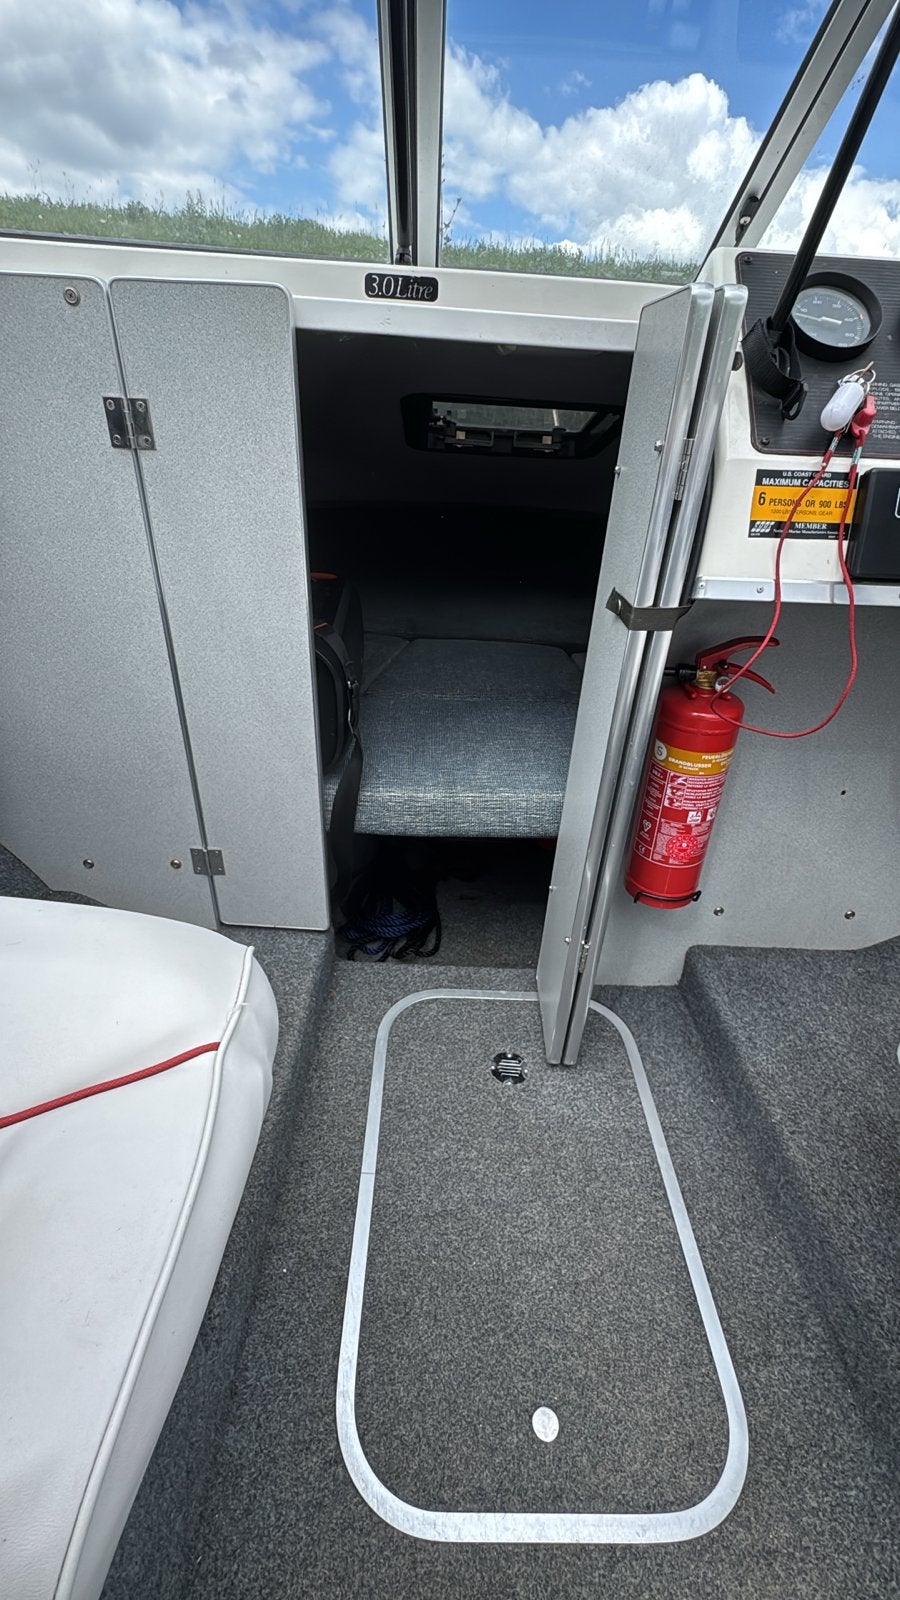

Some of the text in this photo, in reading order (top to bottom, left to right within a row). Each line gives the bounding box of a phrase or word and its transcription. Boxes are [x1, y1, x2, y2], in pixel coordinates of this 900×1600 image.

[761, 477, 800, 487] MAXIMUM
[758, 491, 767, 506] 6
[805, 499, 816, 508] OR
[818, 500, 832, 509] 900
[794, 522, 827, 530] MEMBER
